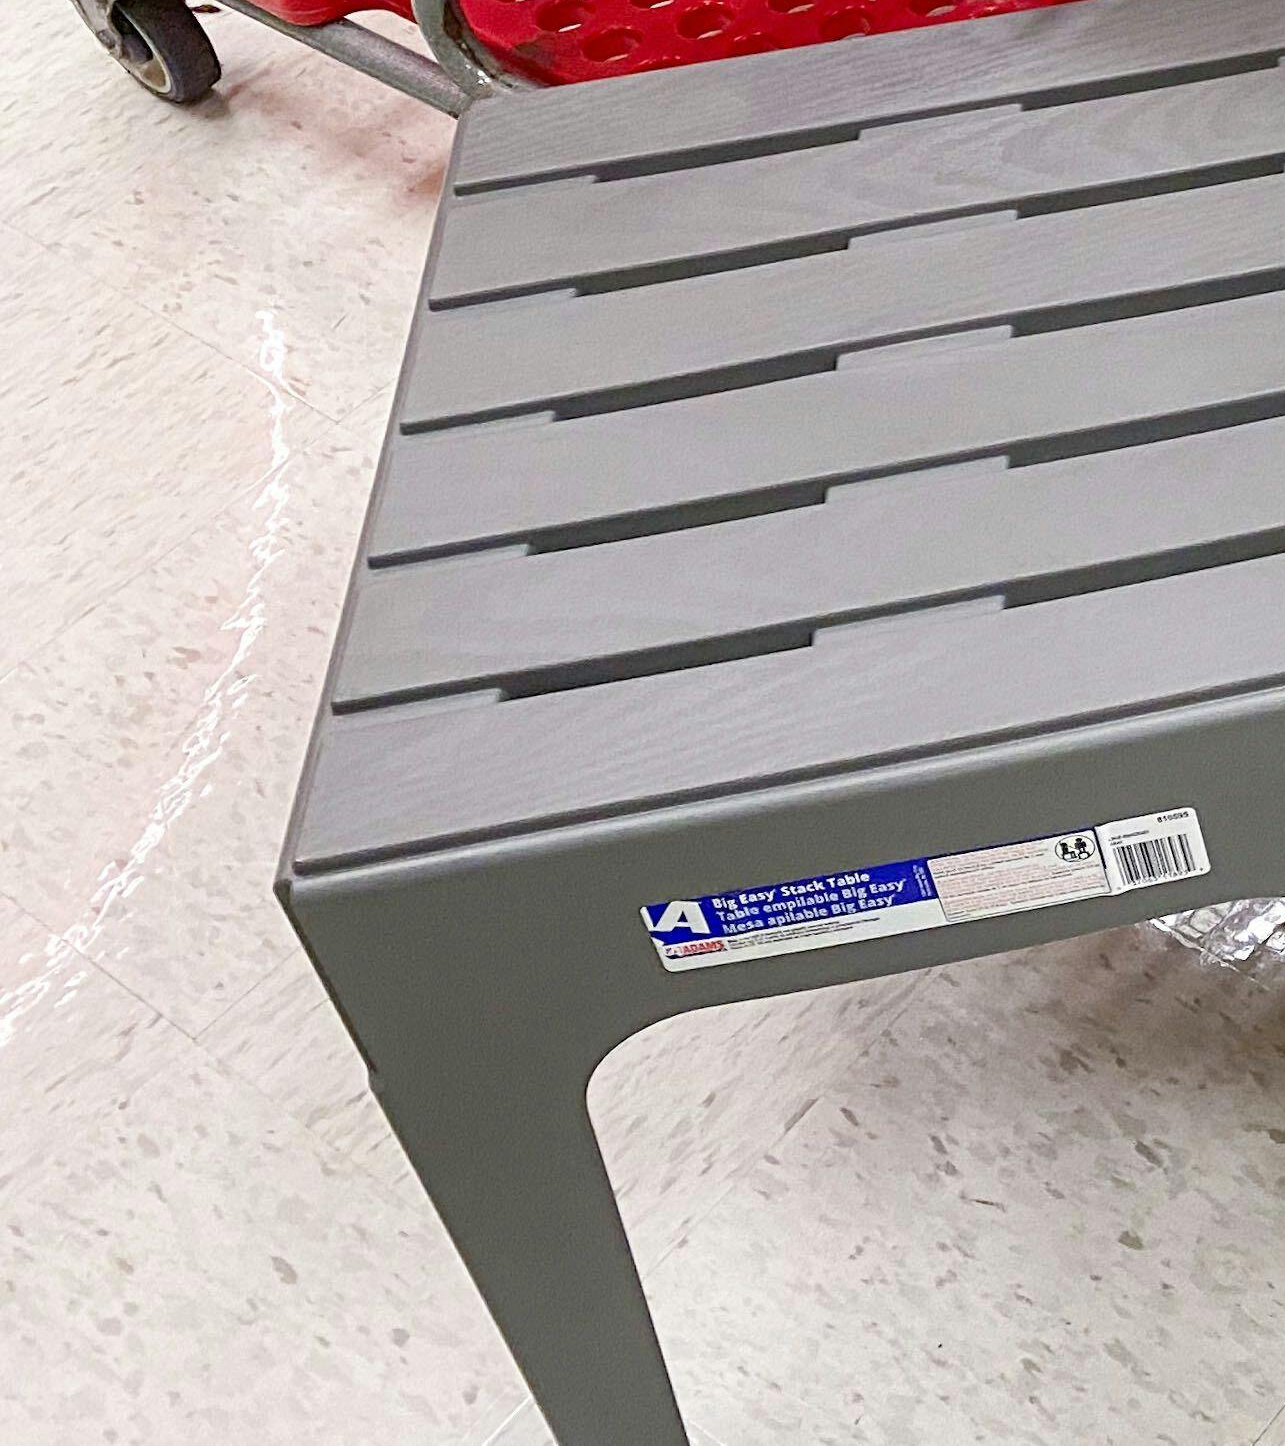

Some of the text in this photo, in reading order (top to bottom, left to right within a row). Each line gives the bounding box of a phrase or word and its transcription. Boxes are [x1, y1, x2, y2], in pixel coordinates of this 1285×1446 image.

[711, 872, 871, 910] Big Easy Stack Table
[716, 905, 761, 922] Table
[763, 891, 839, 914] empilable
[841, 885, 868, 901] Big
[869, 878, 905, 895] Easy
[722, 918, 765, 935] Mesa
[767, 904, 829, 927] apilable
[831, 900, 857, 916] Big
[858, 894, 895, 910] Easy
